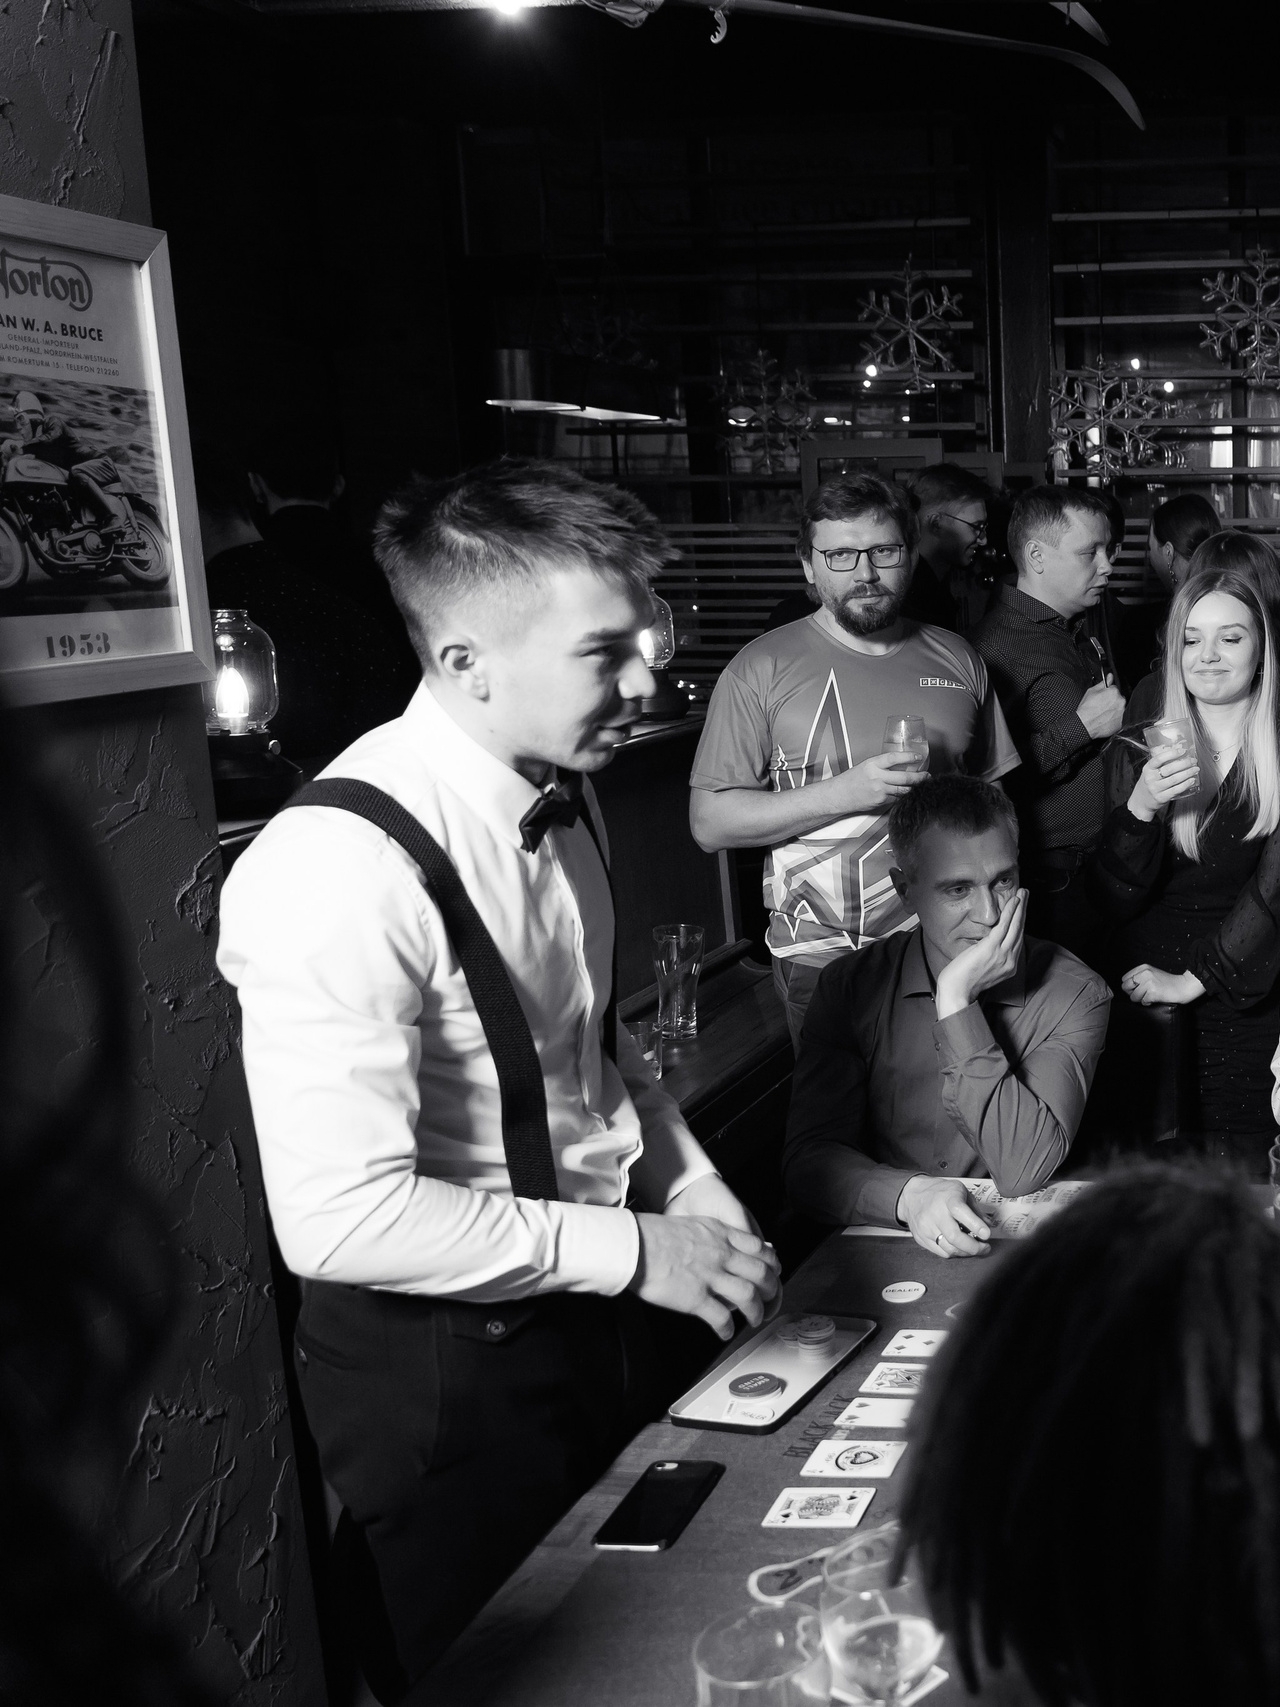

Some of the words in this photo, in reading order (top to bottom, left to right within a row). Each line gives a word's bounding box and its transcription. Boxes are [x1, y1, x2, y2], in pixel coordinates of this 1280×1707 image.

[21, 317, 40, 332] W.
[44, 320, 58, 335] A.
[60, 322, 104, 342] BRUCE
[66, 363, 95, 373] TELEFON
[46, 632, 111, 658] 1953
